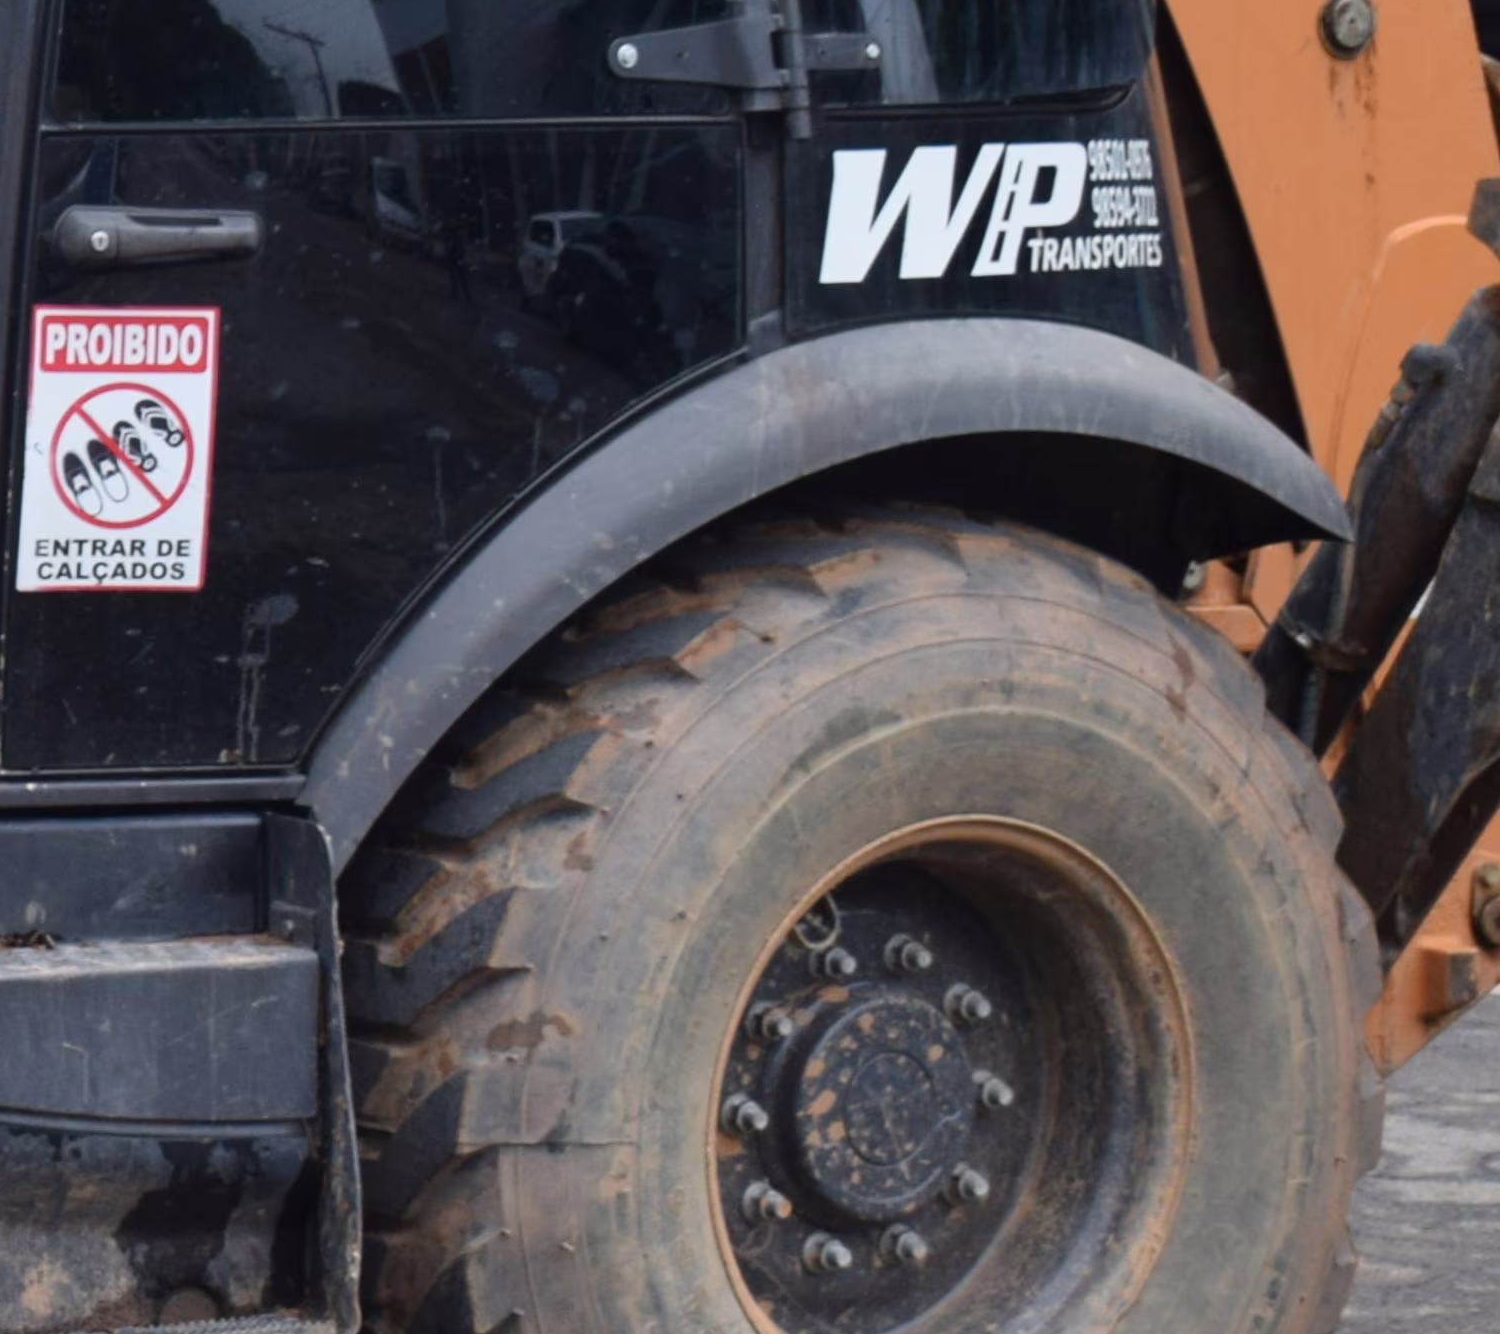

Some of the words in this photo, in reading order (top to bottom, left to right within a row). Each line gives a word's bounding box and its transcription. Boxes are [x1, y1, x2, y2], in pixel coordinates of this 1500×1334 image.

[819, 141, 1088, 284] WP
[1027, 234, 1163, 273] TRANSPORTES
[45, 323, 203, 366] PROIBIDO
[34, 539, 146, 558] ENTRAR
[156, 539, 191, 558] DE
[36, 562, 186, 585] CALÇADOS
